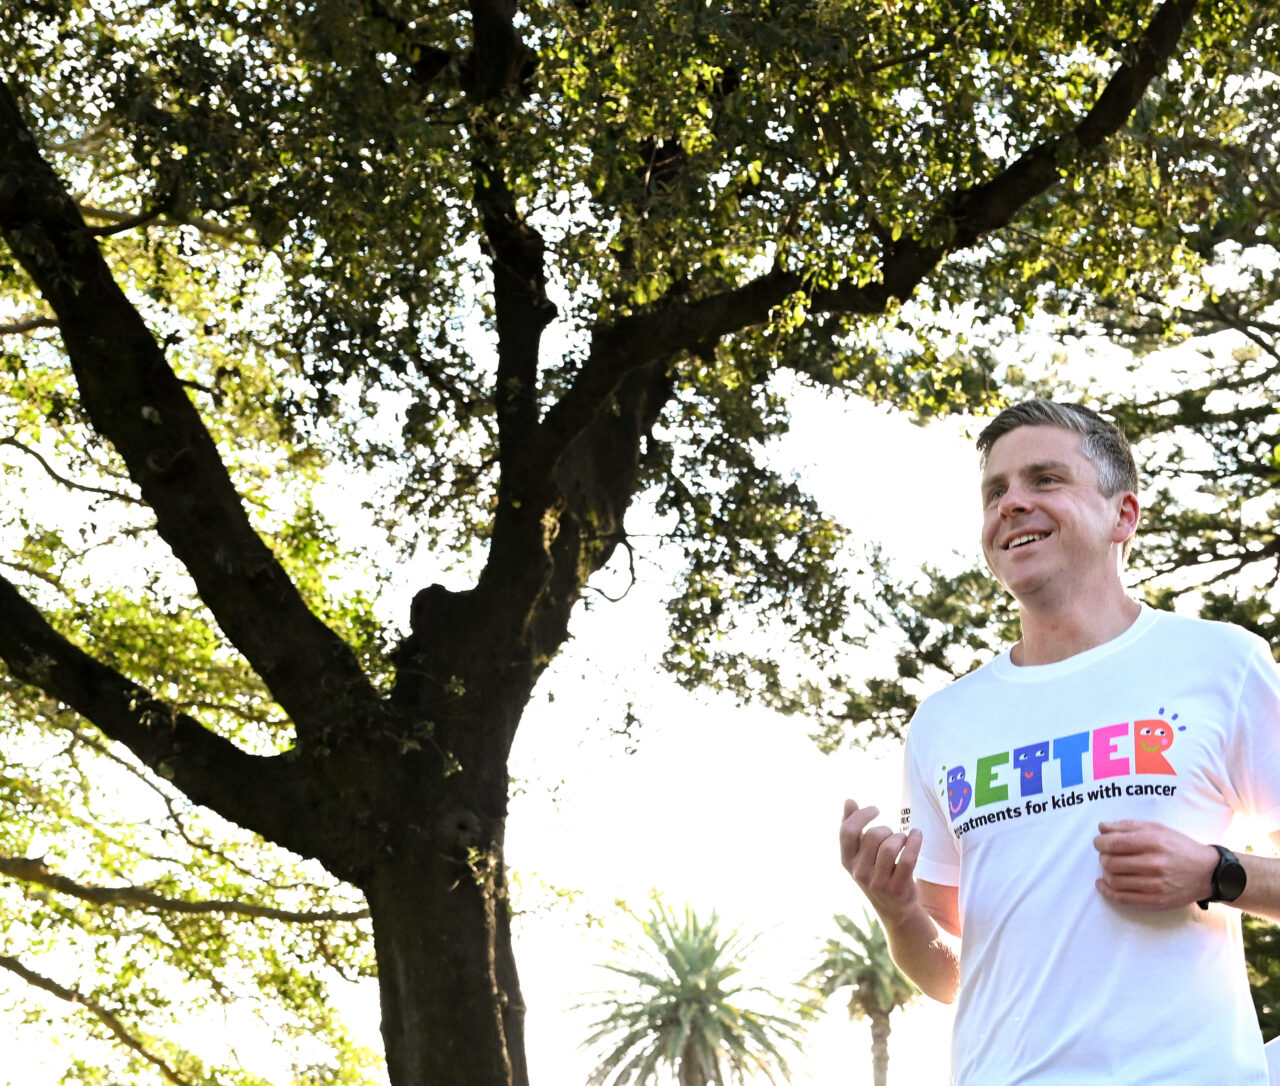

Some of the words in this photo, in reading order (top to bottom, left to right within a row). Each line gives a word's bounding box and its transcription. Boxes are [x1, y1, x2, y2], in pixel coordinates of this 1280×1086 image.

[946, 718, 1178, 822] BETTER
[1025, 799, 1048, 816] for
[1051, 790, 1084, 810] kids
[1087, 782, 1122, 801] with
[1125, 784, 1177, 797] cancer
